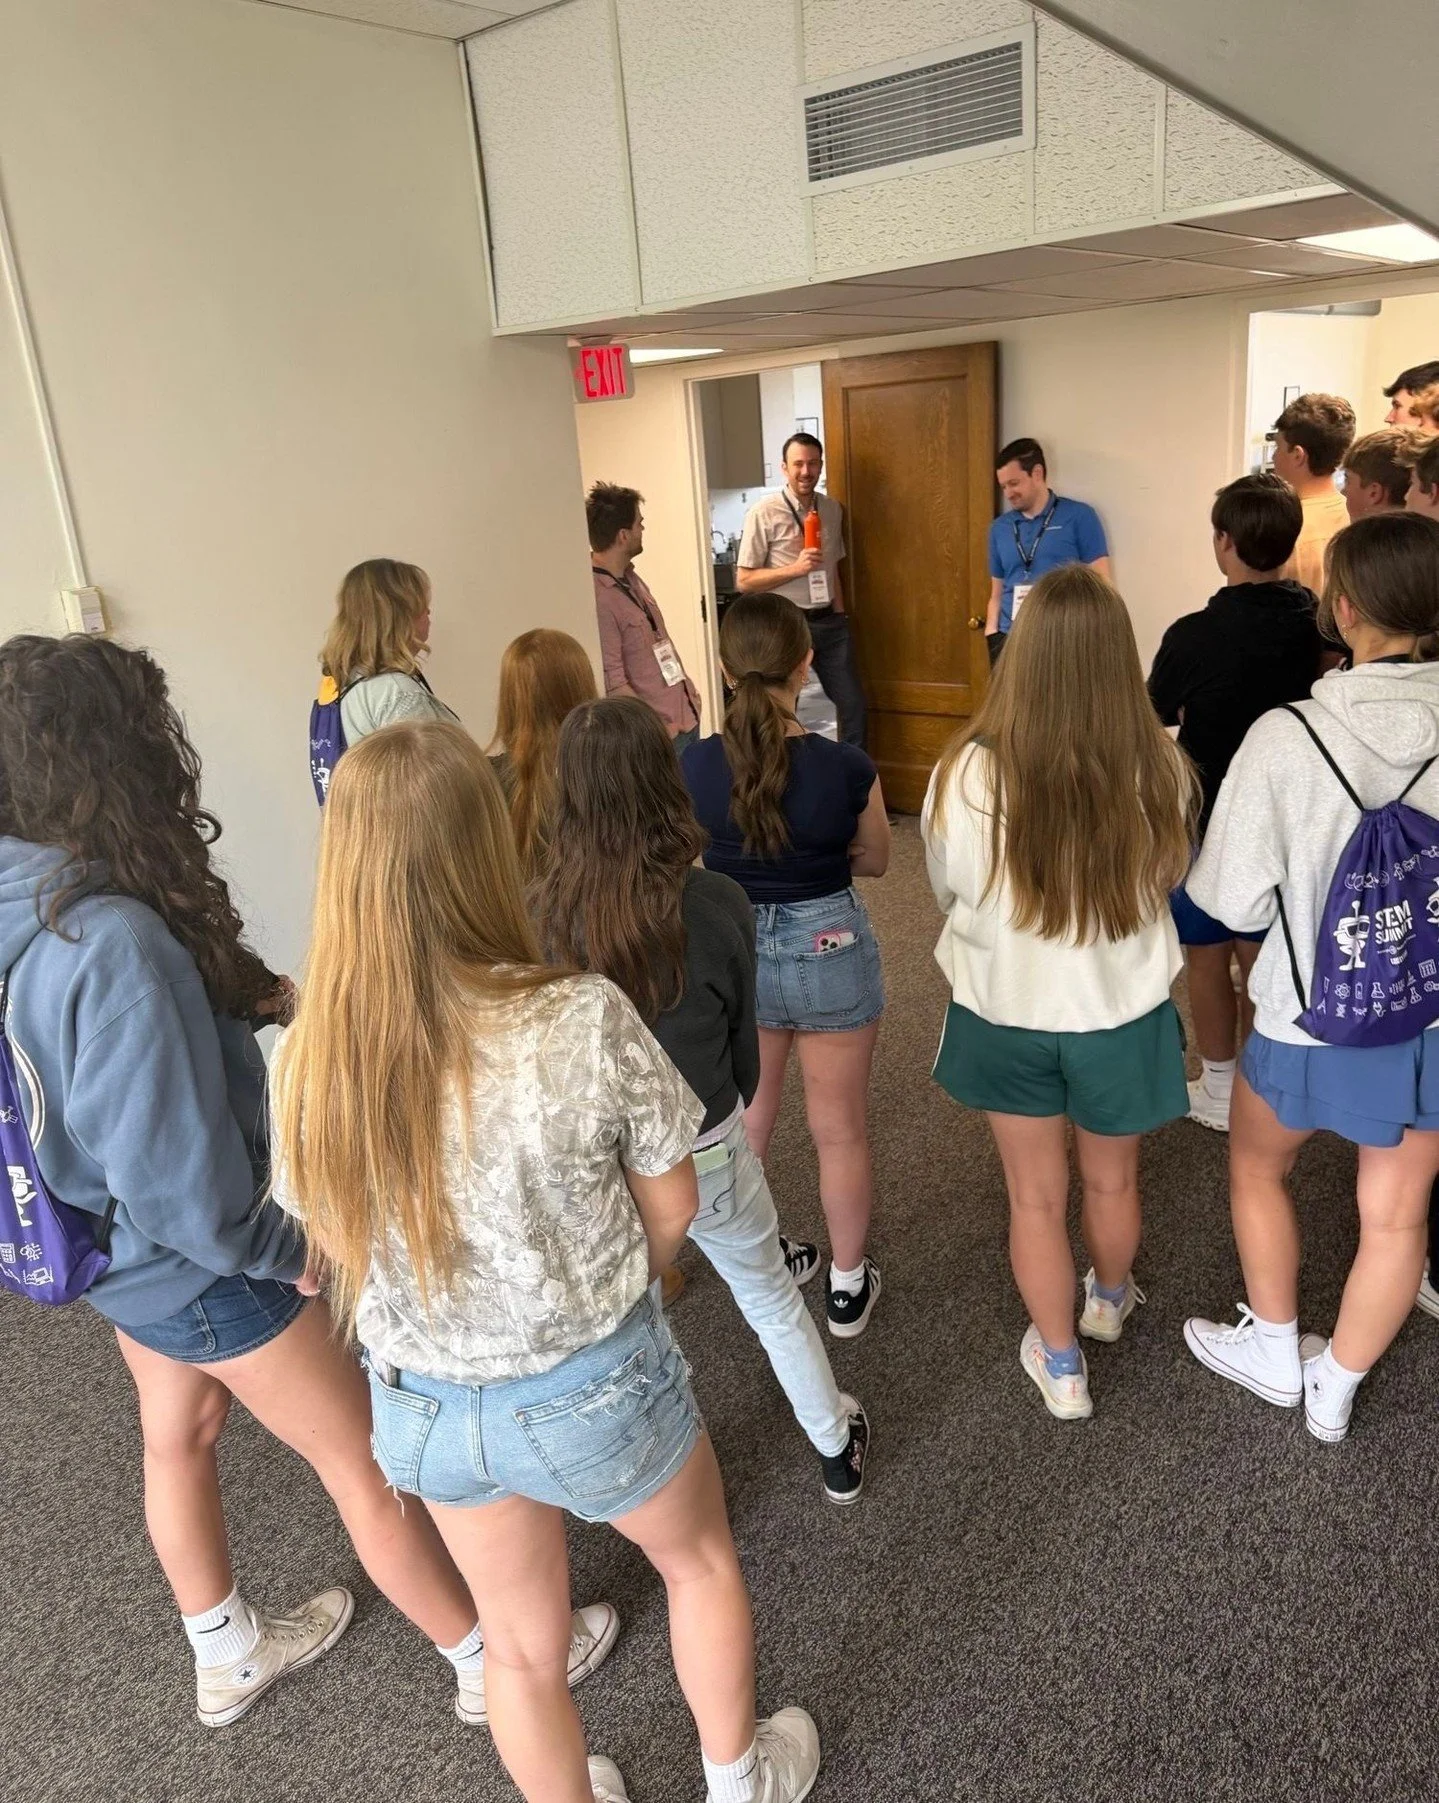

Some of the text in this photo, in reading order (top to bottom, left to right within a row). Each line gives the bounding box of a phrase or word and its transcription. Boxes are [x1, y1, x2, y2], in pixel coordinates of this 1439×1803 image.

[581, 347, 625, 398] EXIT
[1375, 899, 1412, 930] STEM
[1375, 916, 1413, 945] SUMMIT
